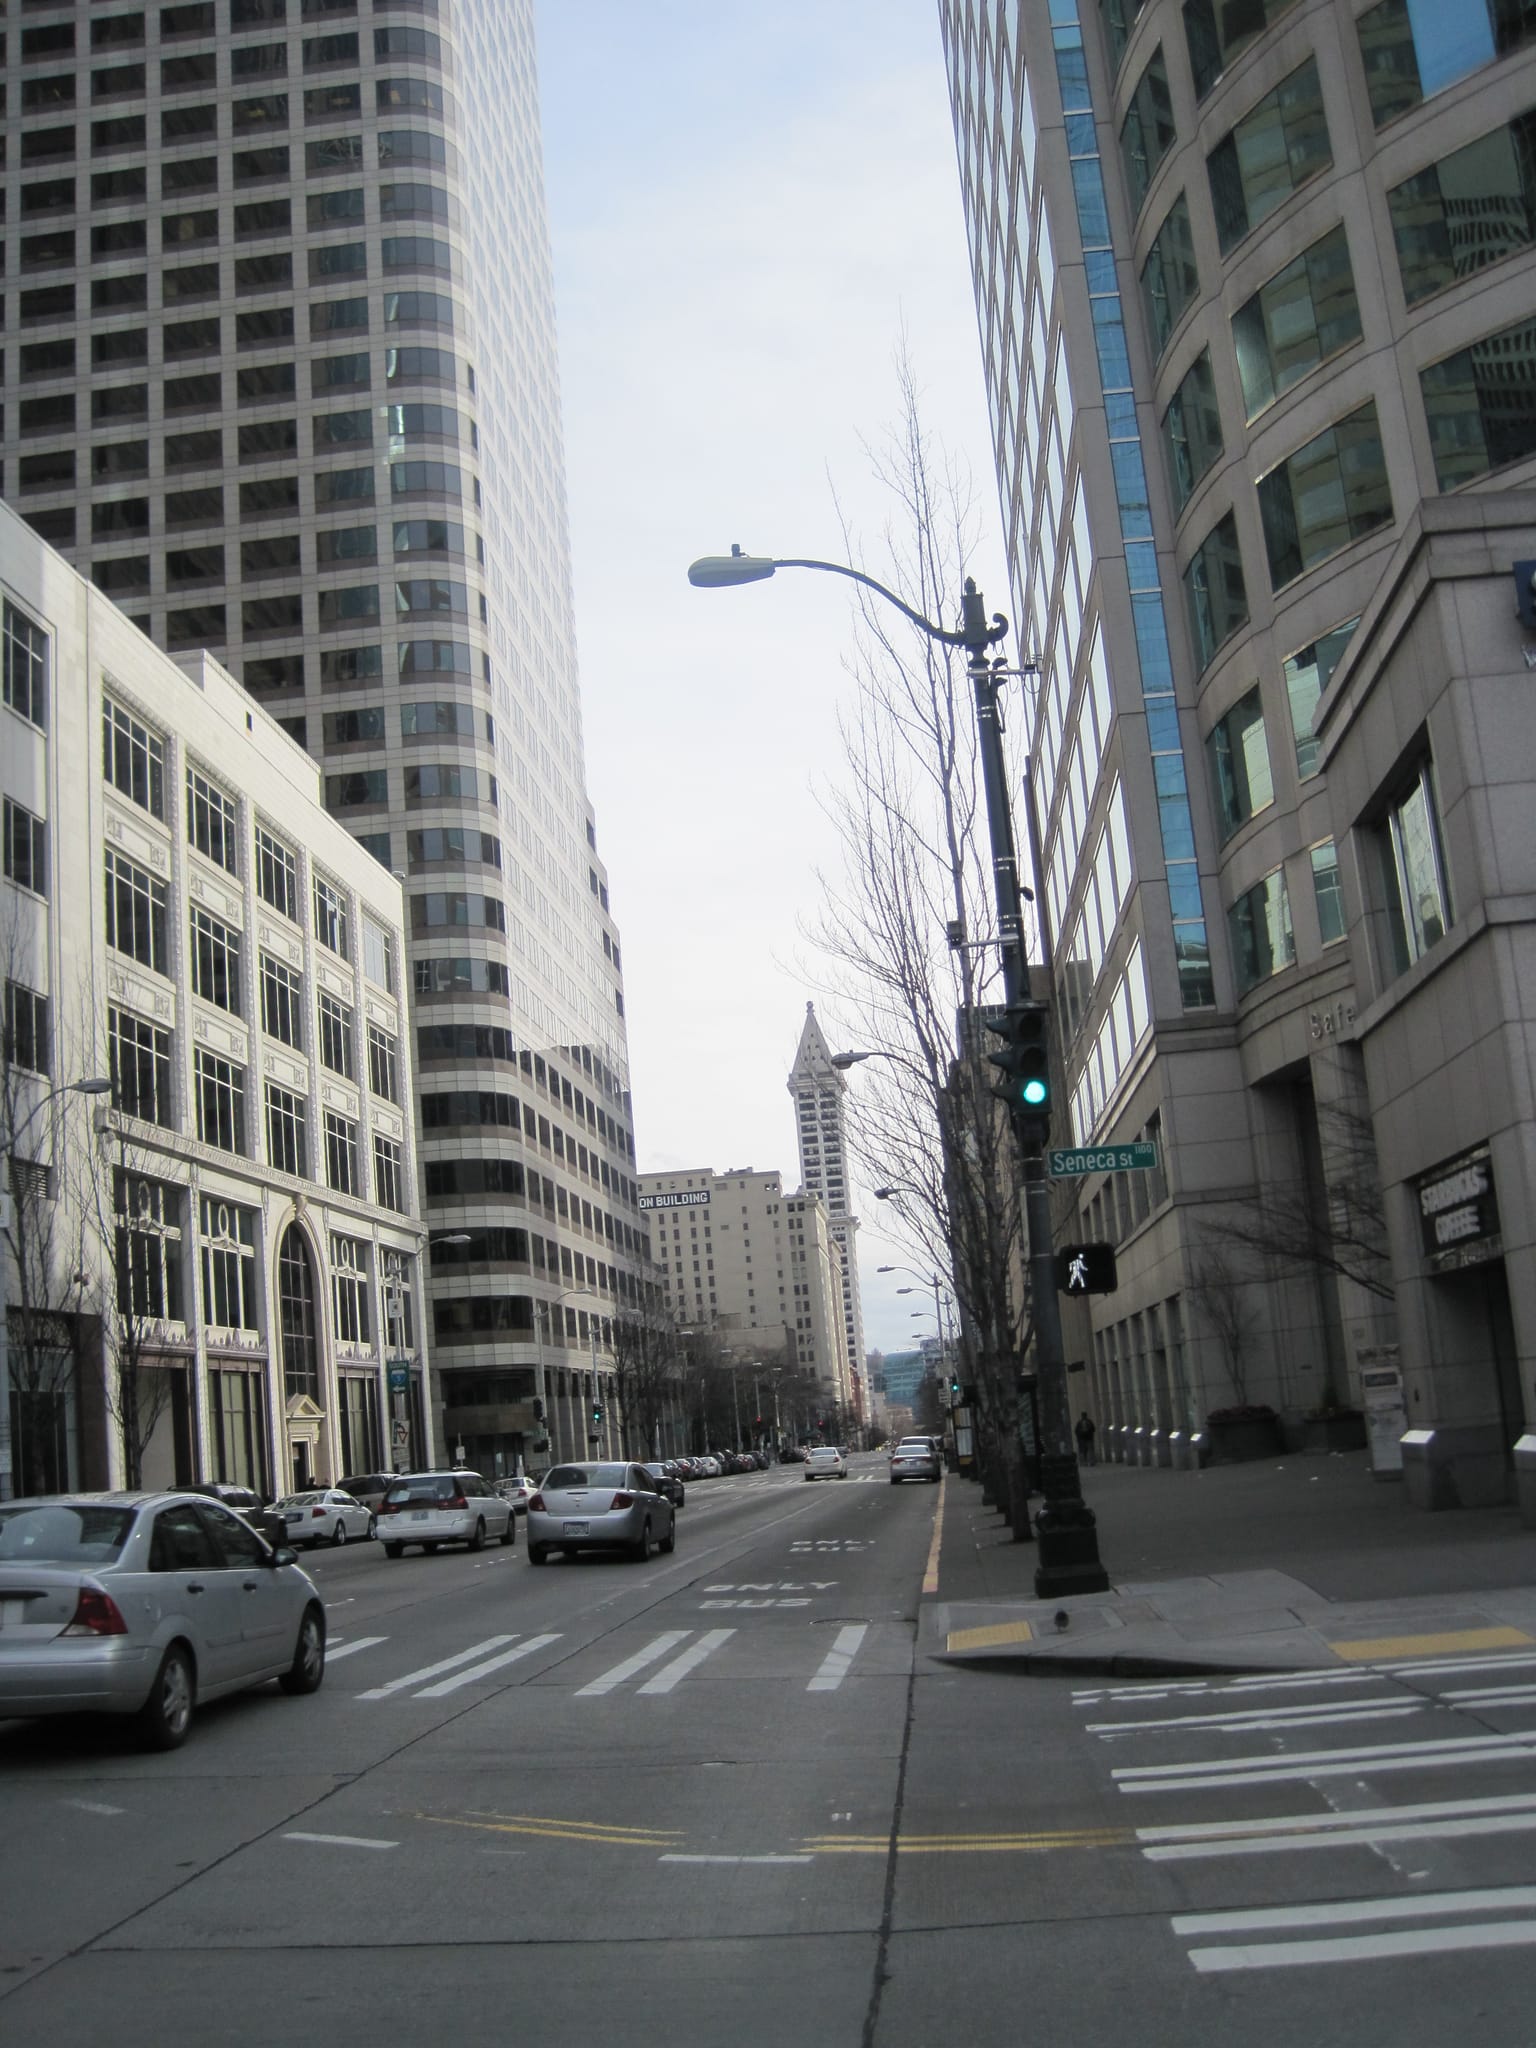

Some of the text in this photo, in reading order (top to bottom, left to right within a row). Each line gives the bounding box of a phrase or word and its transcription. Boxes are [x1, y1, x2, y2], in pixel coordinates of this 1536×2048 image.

[1054, 1153, 1134, 1172] Seneca St
[655, 1192, 709, 1207] BUILDING
[703, 1581, 841, 1592] ONLY
[698, 1598, 813, 1609] BUS
